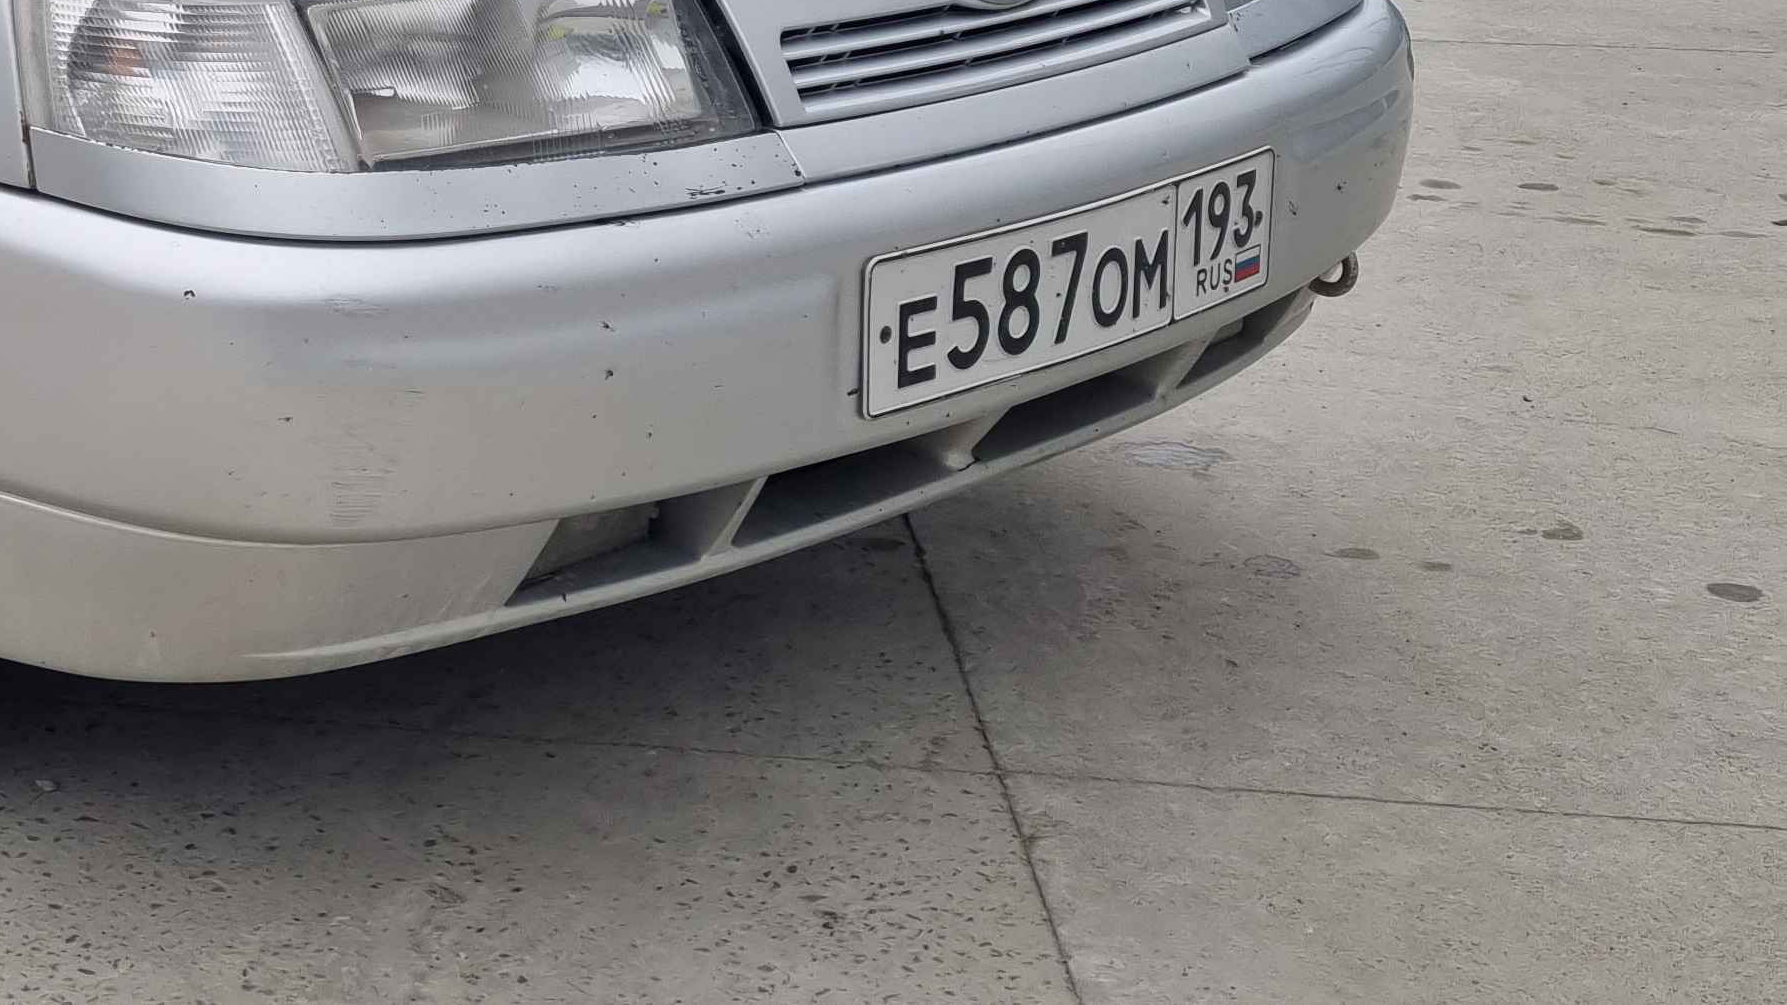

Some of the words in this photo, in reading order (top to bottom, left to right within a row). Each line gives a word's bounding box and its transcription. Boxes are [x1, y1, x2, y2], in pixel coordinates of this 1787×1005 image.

[897, 230, 1169, 389] Е587ОМ
[1182, 168, 1257, 267] 193
[1195, 258, 1233, 297] RUS
